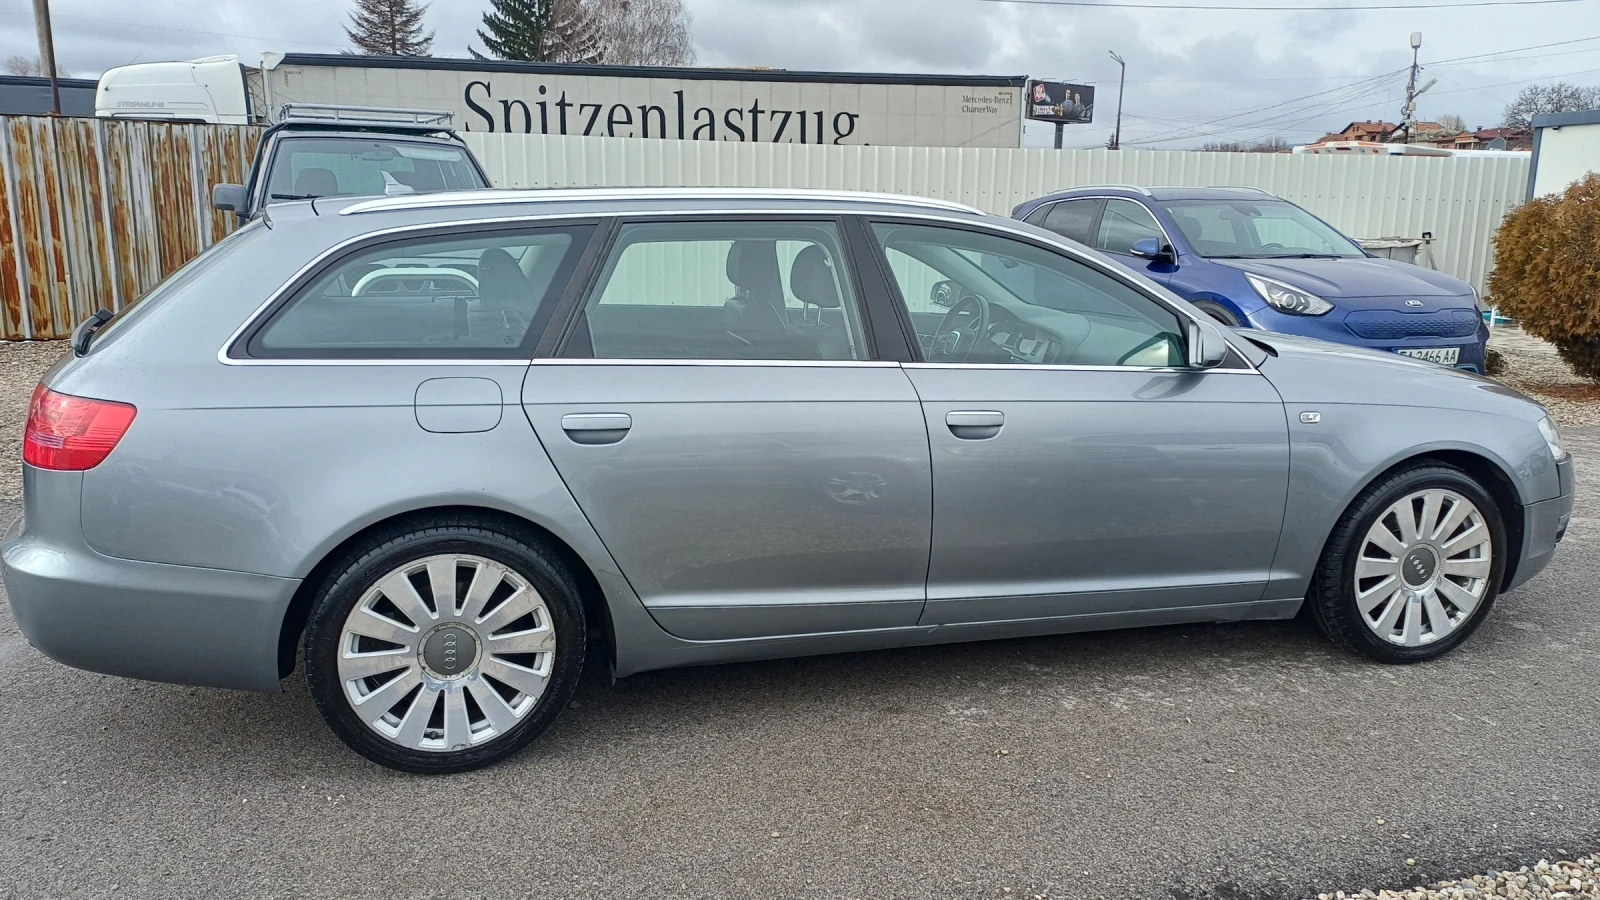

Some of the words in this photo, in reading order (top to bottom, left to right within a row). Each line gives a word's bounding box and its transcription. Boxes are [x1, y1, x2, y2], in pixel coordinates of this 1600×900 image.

[962, 95, 1010, 104] Mercedes-Benz
[464, 80, 870, 146] Spitzenlastzug
[962, 105, 998, 115] CharterWay
[1416, 350, 1441, 363] 2466
[1443, 349, 1456, 363] AA
